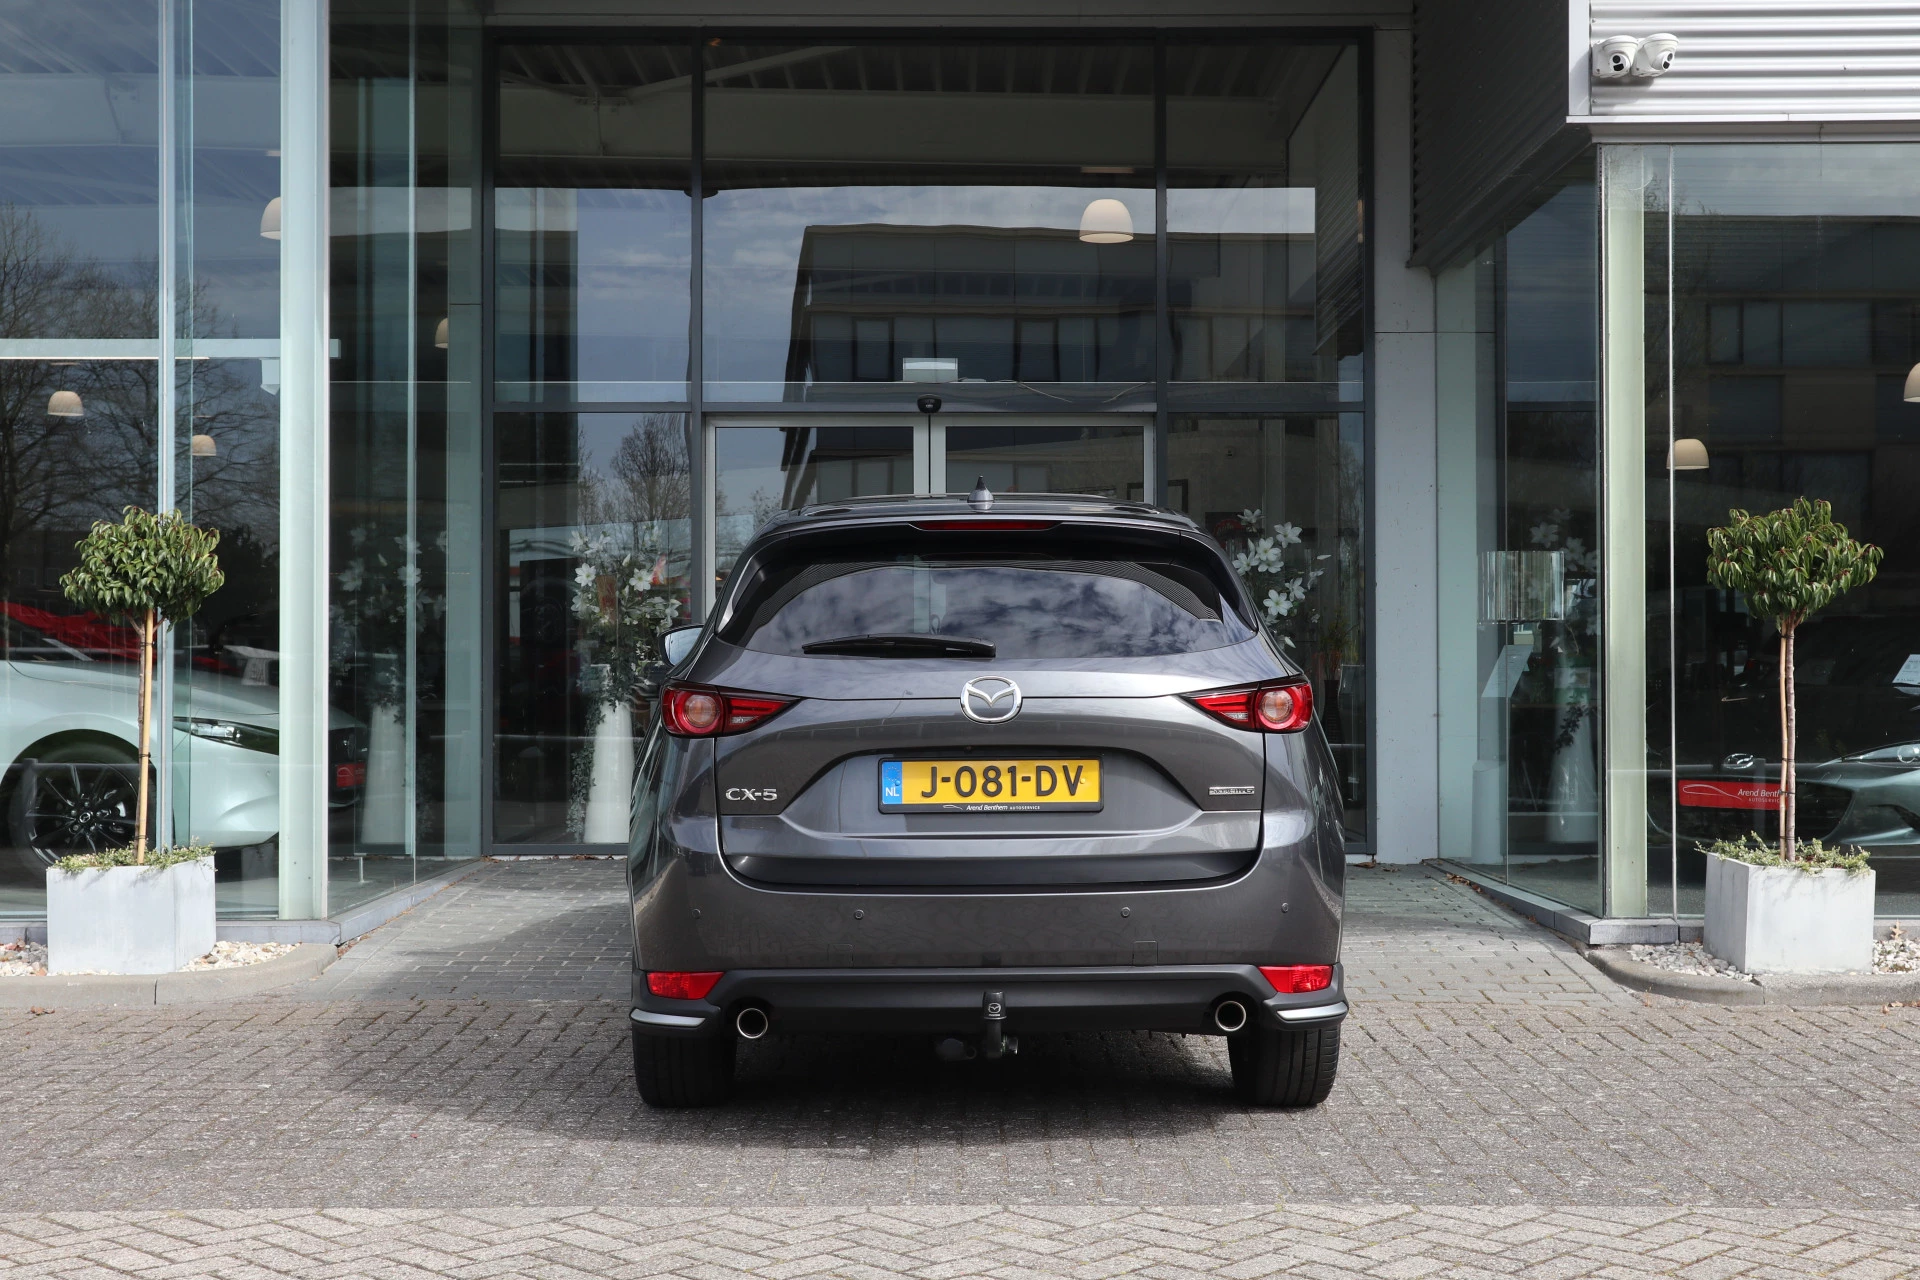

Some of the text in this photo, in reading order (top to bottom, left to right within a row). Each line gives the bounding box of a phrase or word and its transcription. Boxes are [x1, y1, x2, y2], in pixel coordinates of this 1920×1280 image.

[921, 765, 1083, 797] J-081-DV
[725, 788, 778, 801] CX-5
[885, 787, 900, 797] NL
[1737, 788, 1760, 797] Arend
